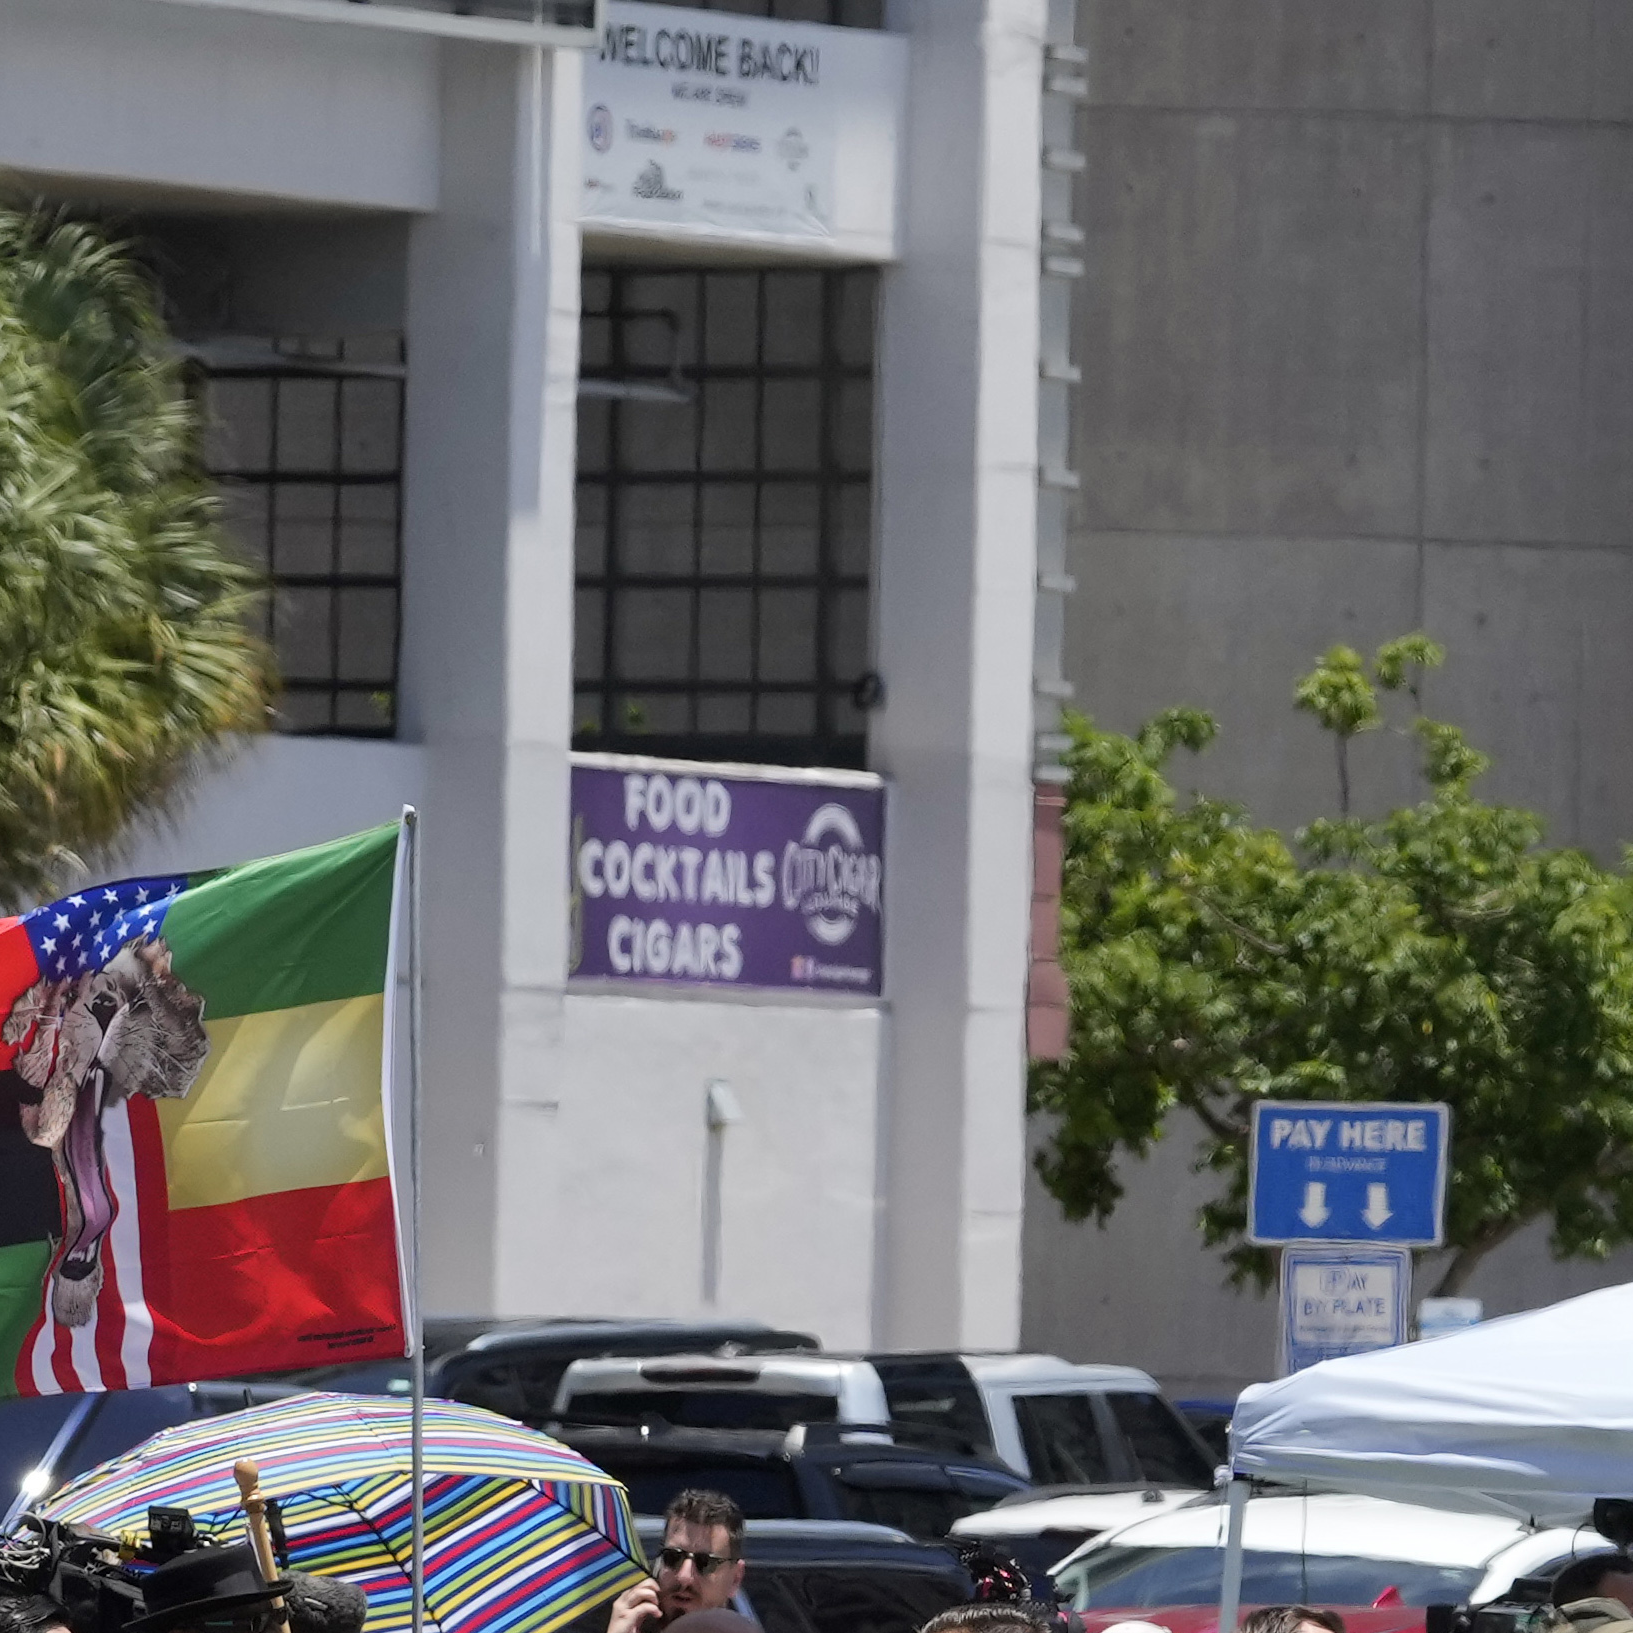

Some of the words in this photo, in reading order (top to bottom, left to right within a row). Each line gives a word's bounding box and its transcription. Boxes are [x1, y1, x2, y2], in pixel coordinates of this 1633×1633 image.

[624, 773, 732, 838] FOOD
[578, 838, 776, 909] COCKTAILS
[607, 914, 743, 980] CIGARS
[1270, 1118, 1333, 1150] PAY
[1338, 1119, 1428, 1152] HERE
